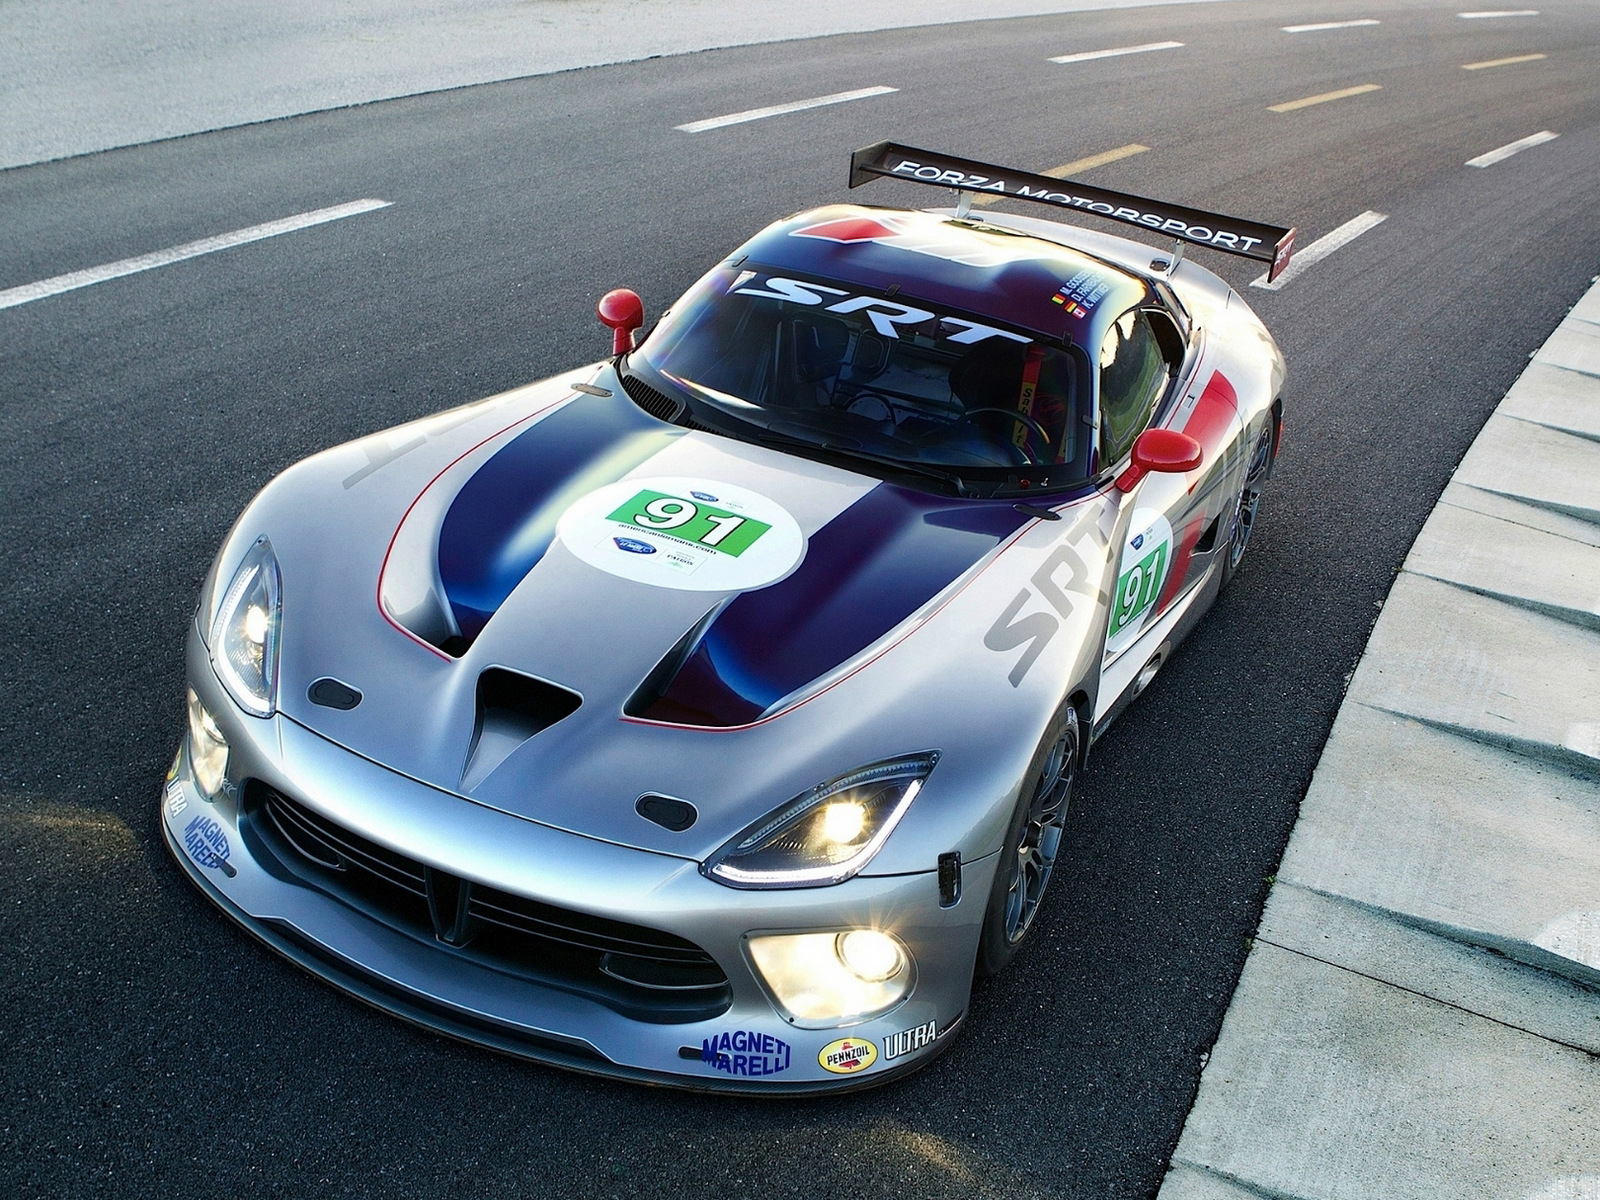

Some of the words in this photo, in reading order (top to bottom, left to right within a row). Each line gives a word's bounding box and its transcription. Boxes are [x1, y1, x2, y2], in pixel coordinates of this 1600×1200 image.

[892, 160, 1004, 192] FORZA
[1016, 186, 1262, 251] MOTORSPORT
[734, 277, 1034, 344] SRT
[1016, 388, 1033, 443] Sablt
[633, 497, 748, 547] 91
[983, 503, 1114, 689] SRT
[1118, 549, 1161, 627] 91
[166, 776, 189, 818] ULTRA
[701, 1050, 790, 1076] MARELLI
[702, 1030, 790, 1056] MAGNETI
[827, 1045, 870, 1066] PENNZOIL
[882, 1019, 937, 1060] ULTRA
